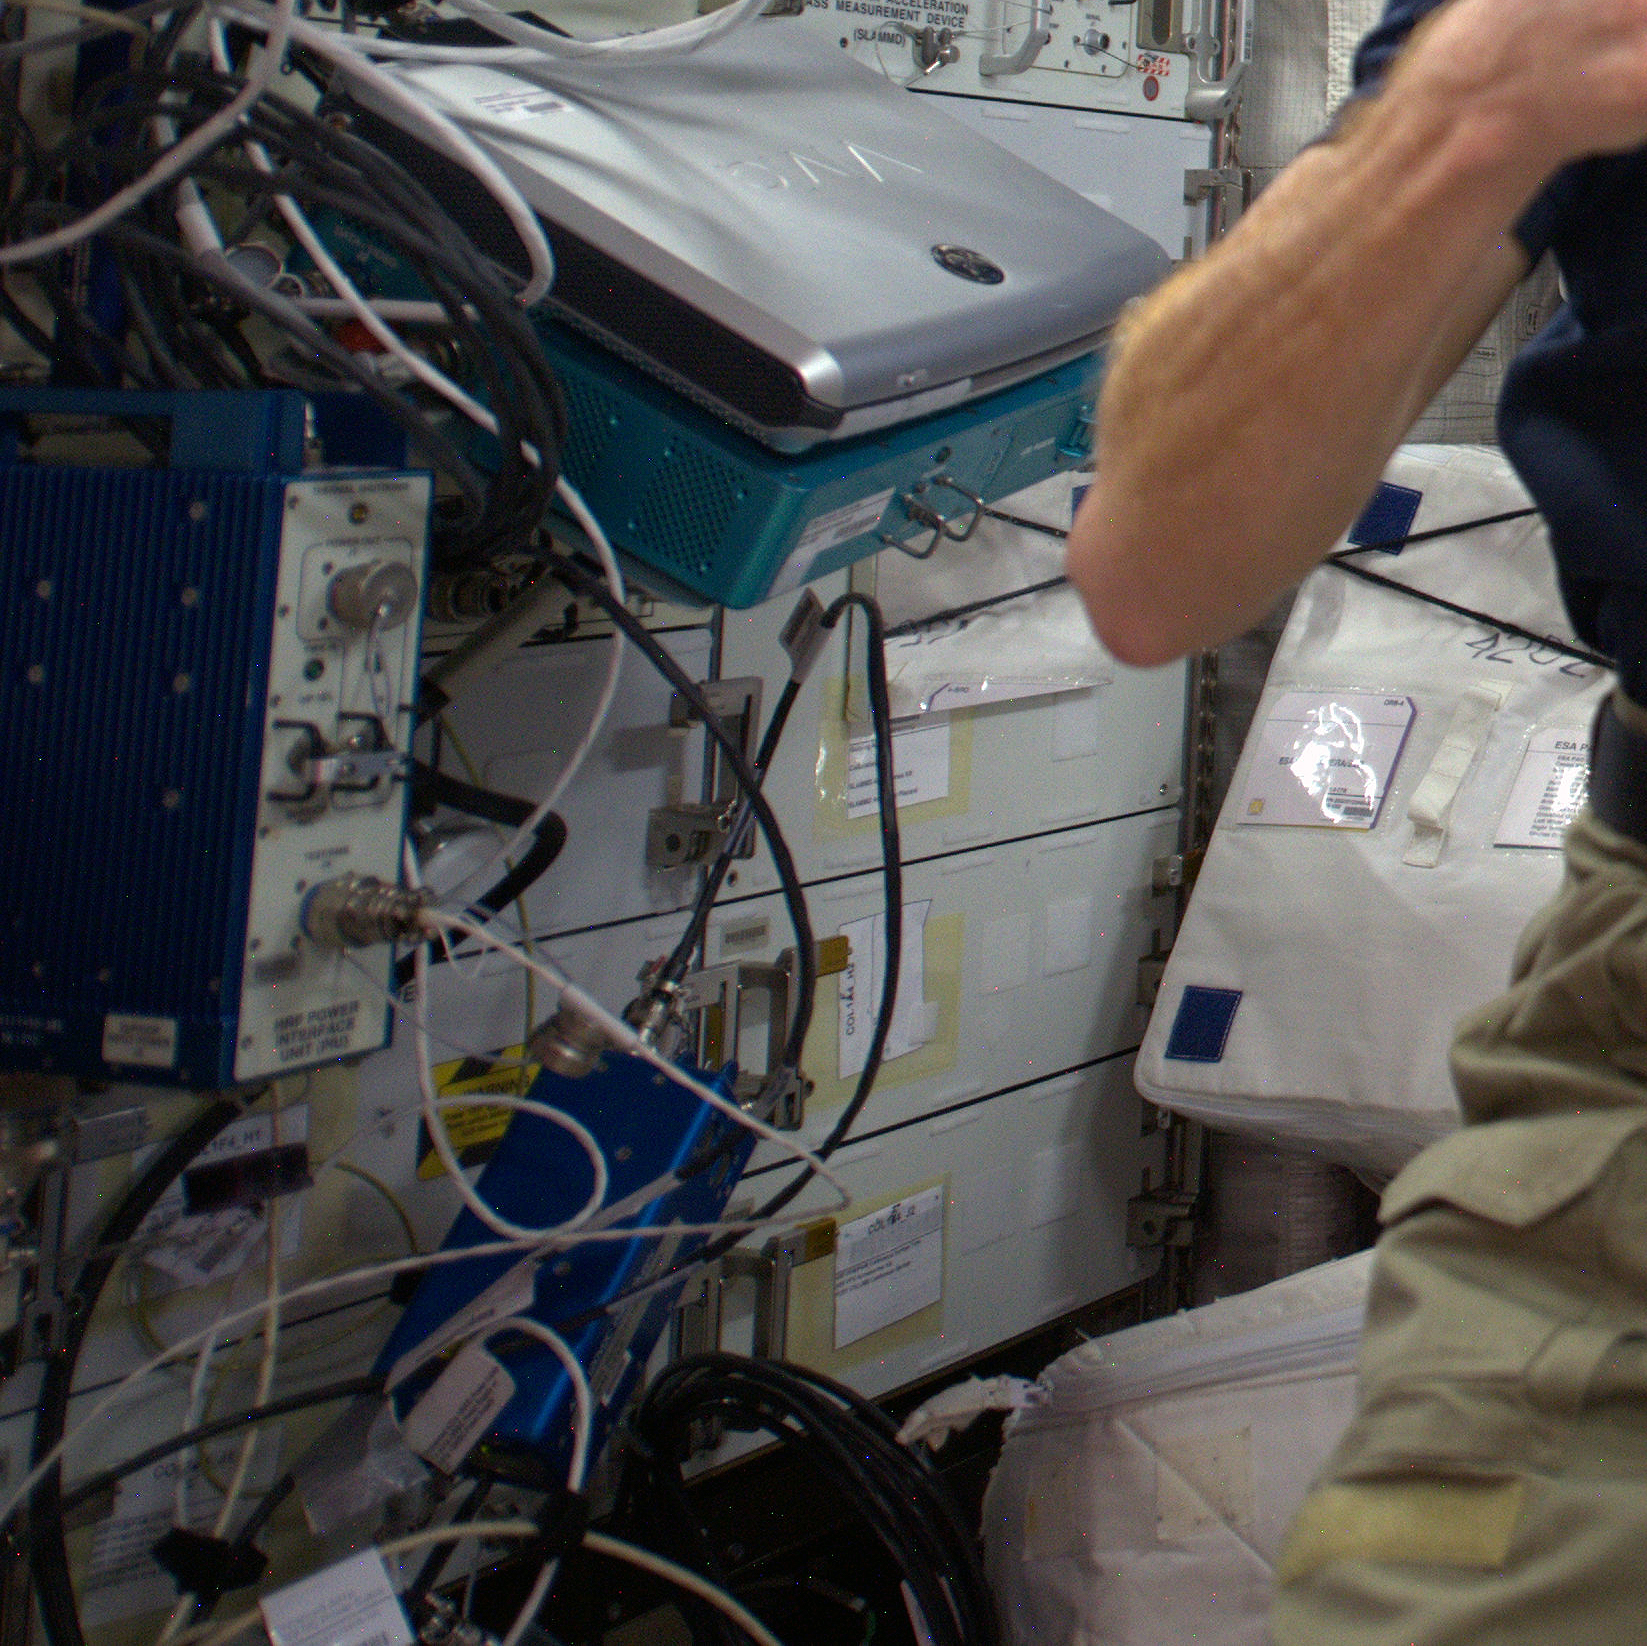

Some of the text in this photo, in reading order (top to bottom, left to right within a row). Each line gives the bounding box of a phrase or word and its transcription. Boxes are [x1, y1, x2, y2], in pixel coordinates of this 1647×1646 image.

[836, 0, 921, 22] MEASUREMENT
[927, 13, 966, 29] DEVICE
[1555, 741, 1577, 751] ESA
